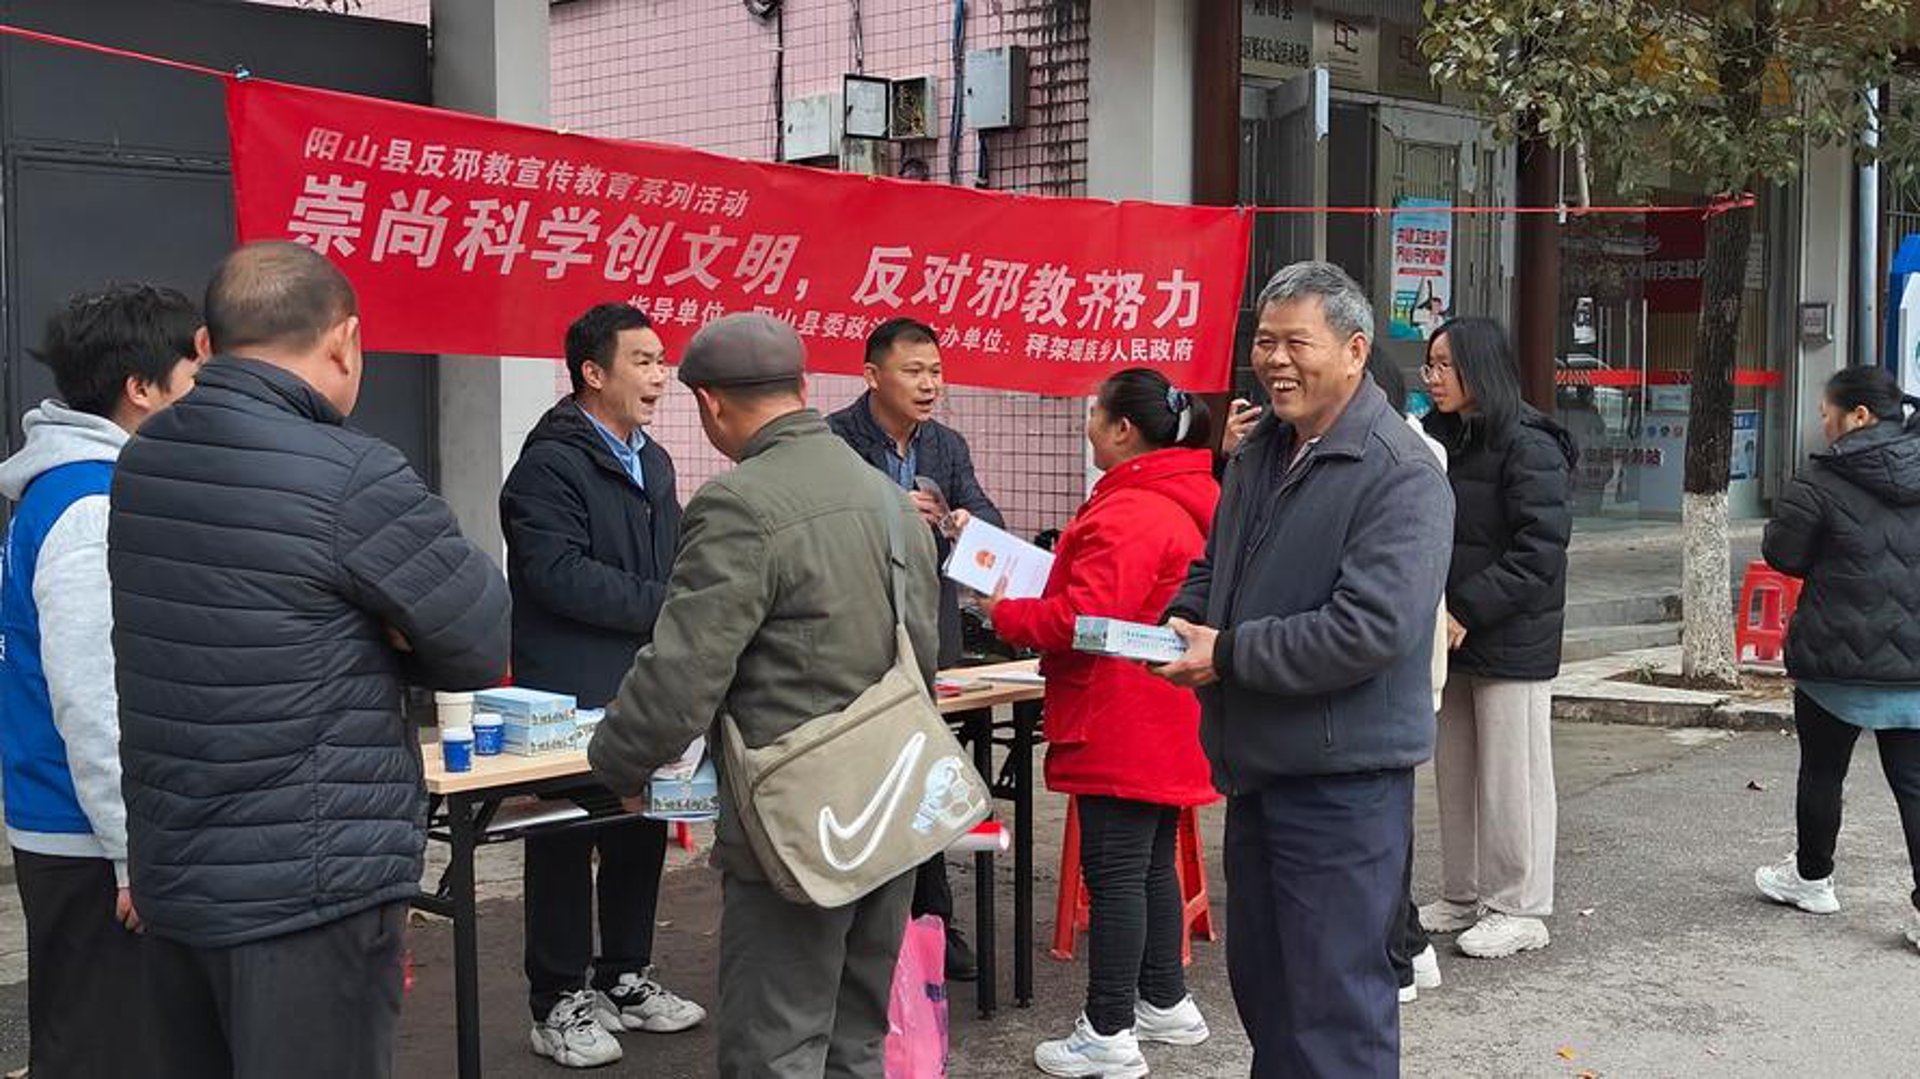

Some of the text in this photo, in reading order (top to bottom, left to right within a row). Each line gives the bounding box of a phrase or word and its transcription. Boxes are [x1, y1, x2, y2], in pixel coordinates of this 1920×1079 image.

[304, 127, 749, 217] 阳山县反邪教宣传教育系列活动
